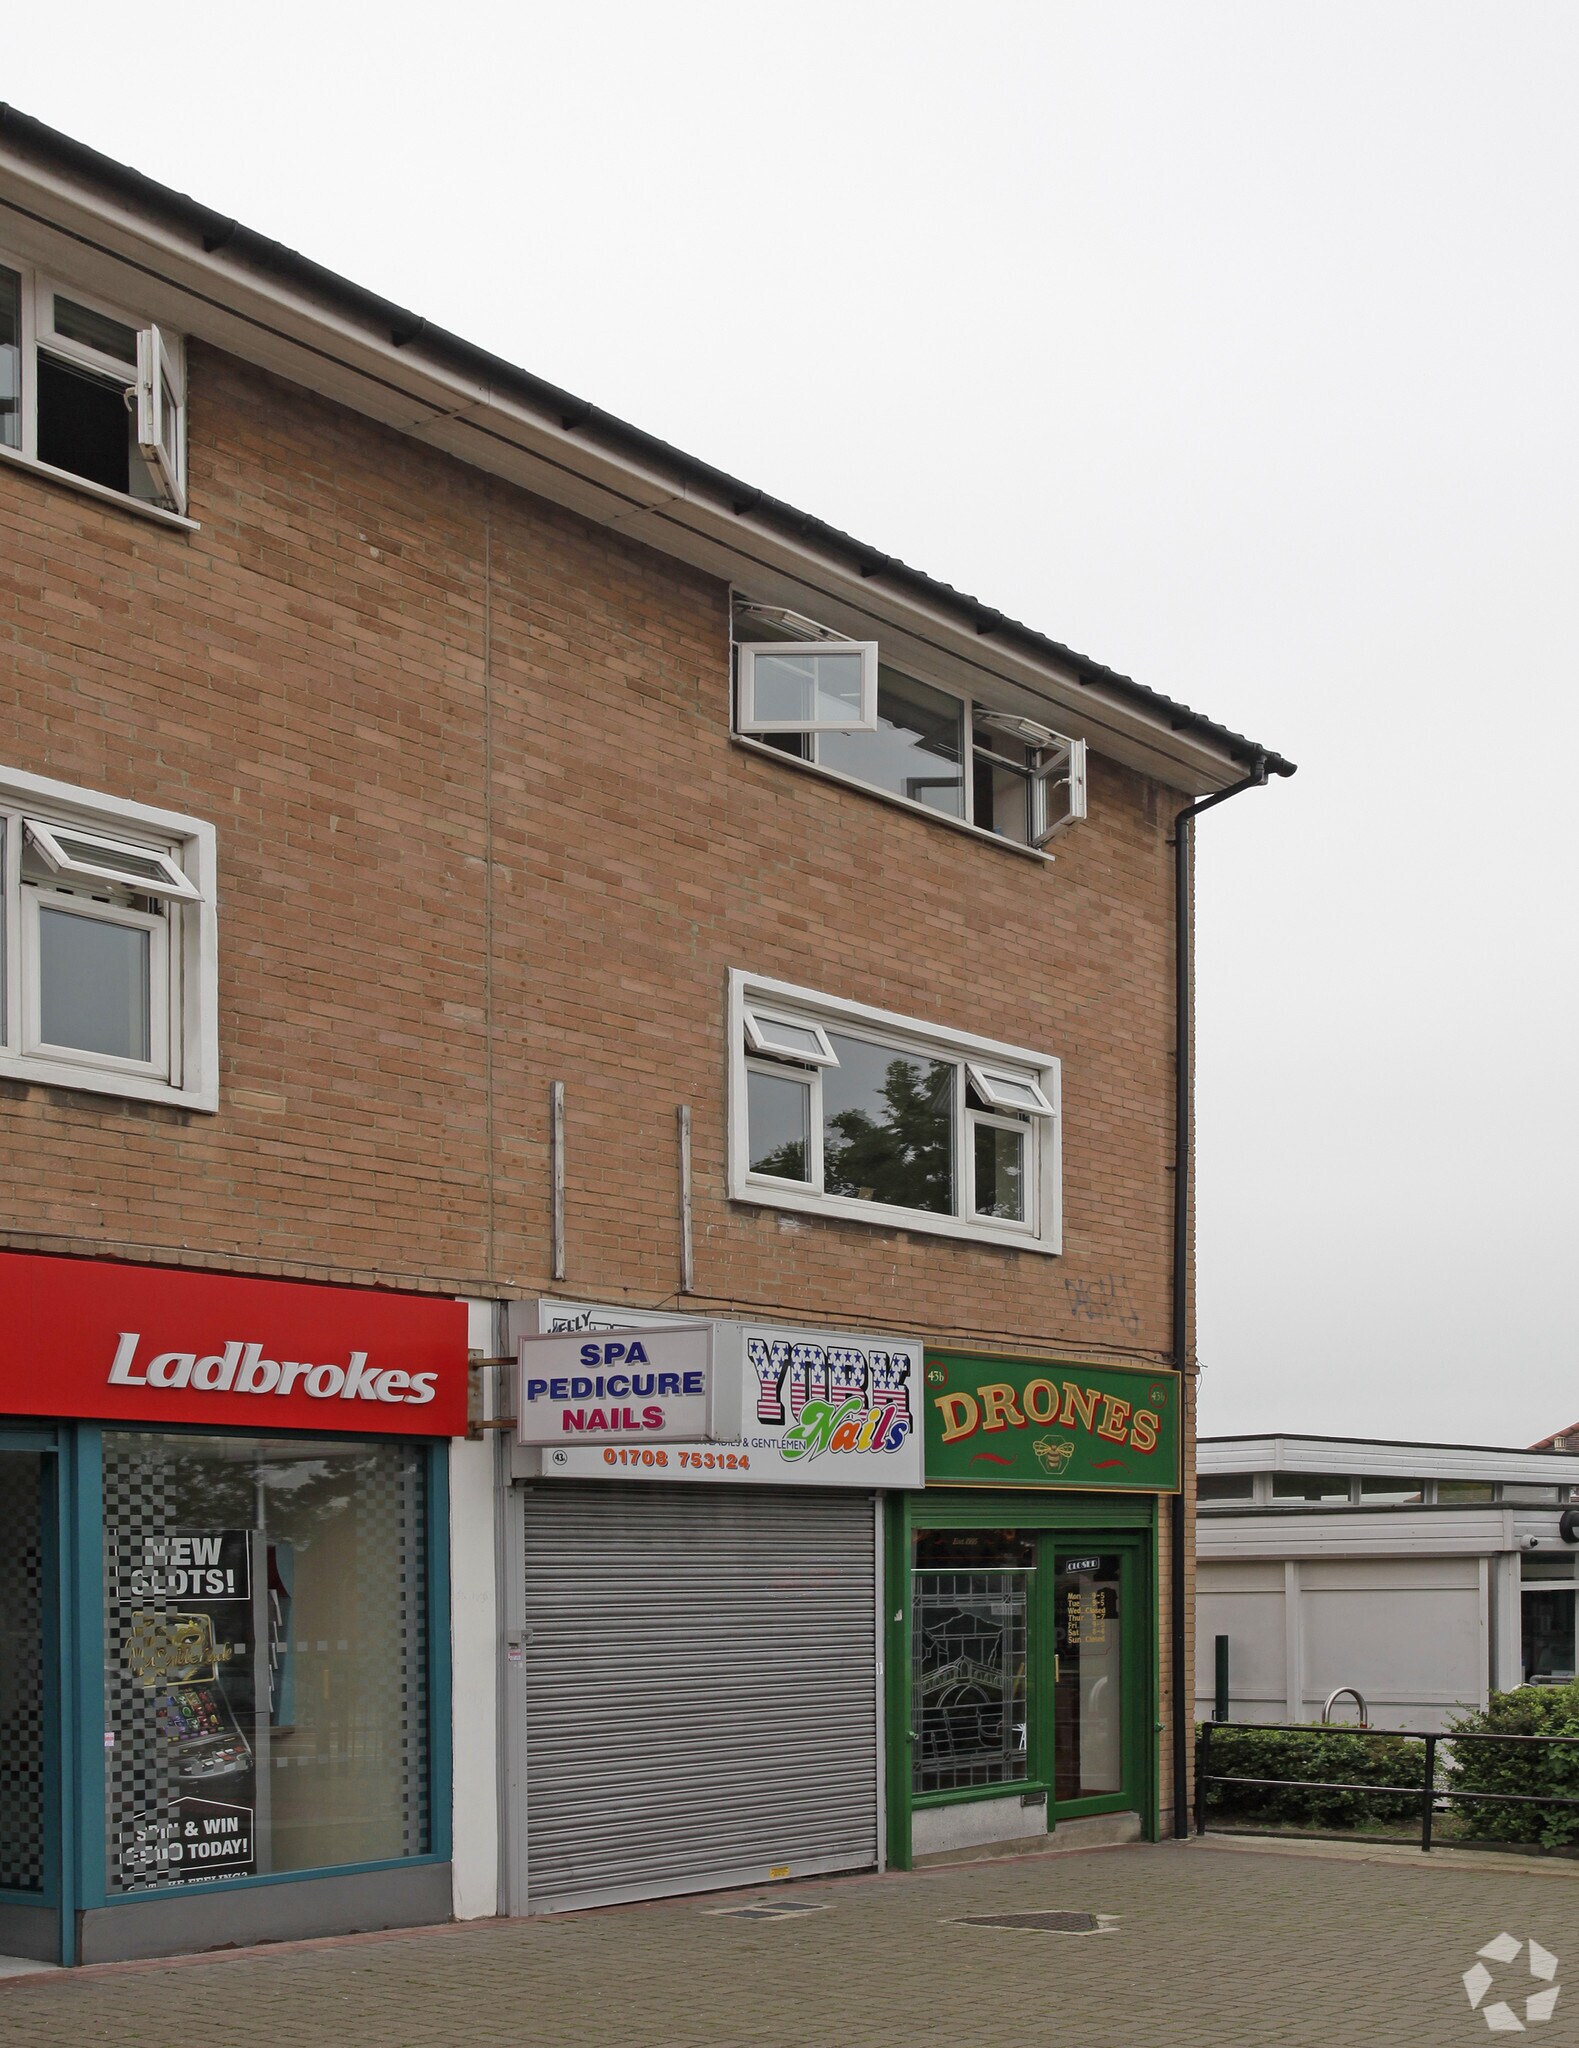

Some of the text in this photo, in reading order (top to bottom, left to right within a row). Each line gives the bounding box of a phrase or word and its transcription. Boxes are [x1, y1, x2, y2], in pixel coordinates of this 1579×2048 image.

[580, 1342, 652, 1367] SPA
[108, 1332, 438, 1404] Ladbrokes
[527, 1371, 704, 1401] PEDICURE
[748, 1338, 913, 1434] YORK
[562, 1406, 666, 1432] NAILS
[780, 1396, 911, 1462] Nails
[934, 1379, 1161, 1455] DRONES
[742, 1437, 749, 1447] &
[751, 1438, 807, 1449] GENTLEMEN
[603, 1448, 750, 1470] 01708 753124
[144, 1537, 223, 1566] NEW
[1067, 1560, 1098, 1571] CLOSED
[131, 1569, 235, 1595] SLOTS!
[184, 1821, 199, 1837] &
[203, 1816, 239, 1835] WIN
[187, 1838, 248, 1859] TODAY!
